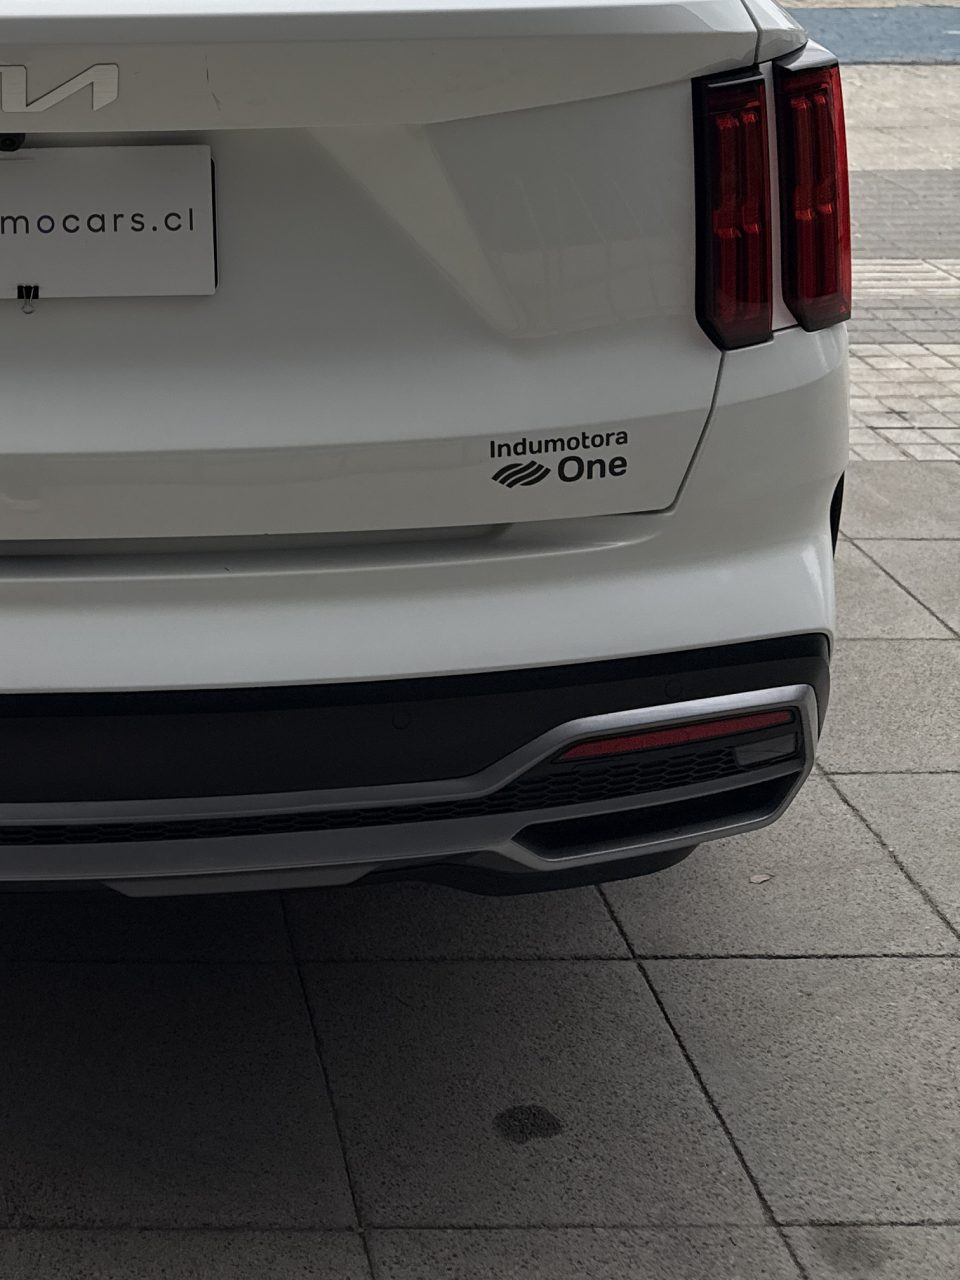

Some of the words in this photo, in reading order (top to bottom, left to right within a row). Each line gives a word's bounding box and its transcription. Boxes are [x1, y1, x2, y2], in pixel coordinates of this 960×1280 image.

[0, 208, 194, 234] mocars.cl
[490, 431, 628, 458] Indumotora
[557, 455, 627, 483] One
